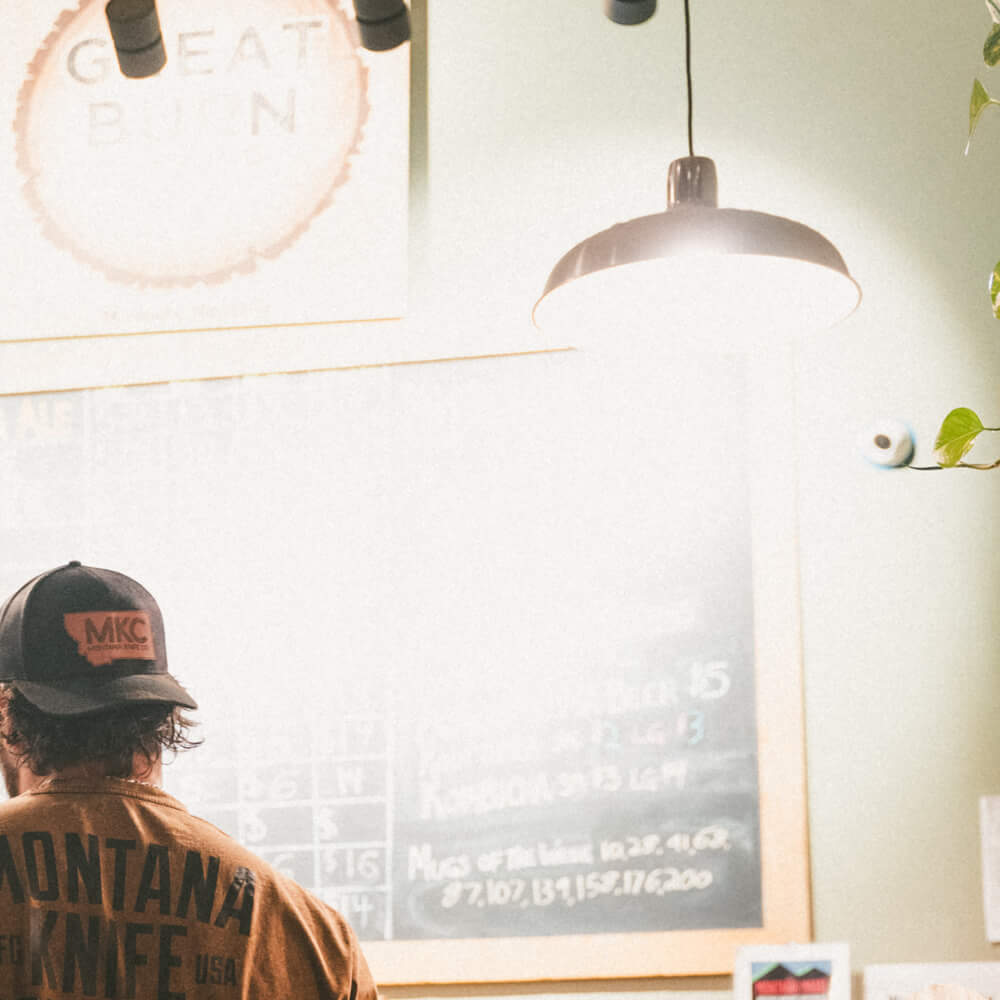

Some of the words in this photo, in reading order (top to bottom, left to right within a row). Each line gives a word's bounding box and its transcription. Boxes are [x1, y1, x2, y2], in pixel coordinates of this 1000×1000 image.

[66, 20, 322, 84] GEAT
[84, 616, 148, 645] MKC
[195, 952, 236, 987] USA
